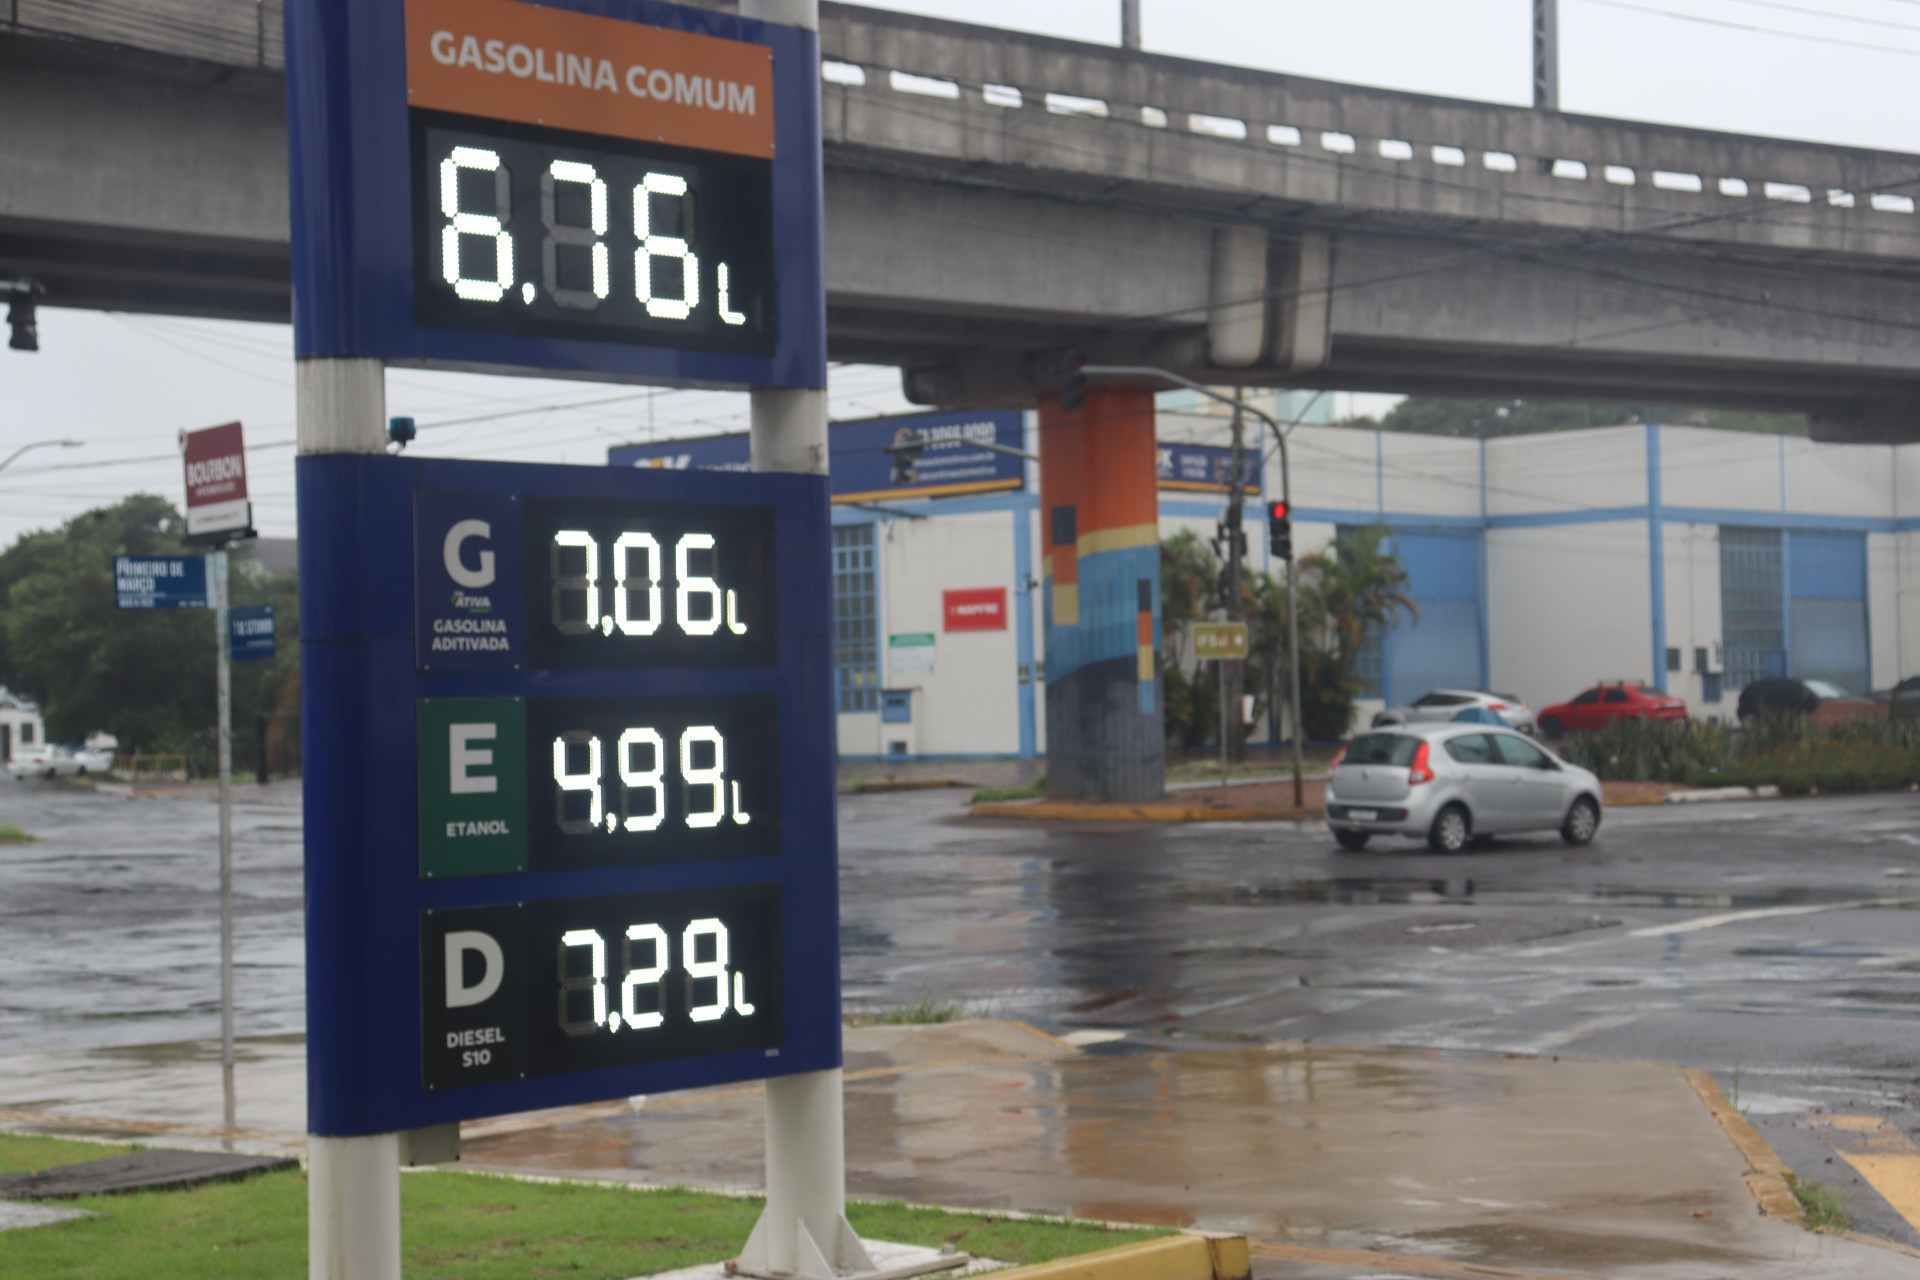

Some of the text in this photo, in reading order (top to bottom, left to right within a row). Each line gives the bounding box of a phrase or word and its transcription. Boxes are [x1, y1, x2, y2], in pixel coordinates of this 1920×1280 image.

[430, 31, 756, 115] GASOLINA COMUM
[443, 519, 496, 588] G
[433, 619, 507, 633] GASOLINA
[431, 637, 509, 651] ADITIVADA
[449, 722, 498, 794] E
[446, 820, 510, 838] ETANOL
[444, 930, 505, 1008] D
[446, 1028, 505, 1050] DIESEL
[462, 1048, 491, 1067] S10
